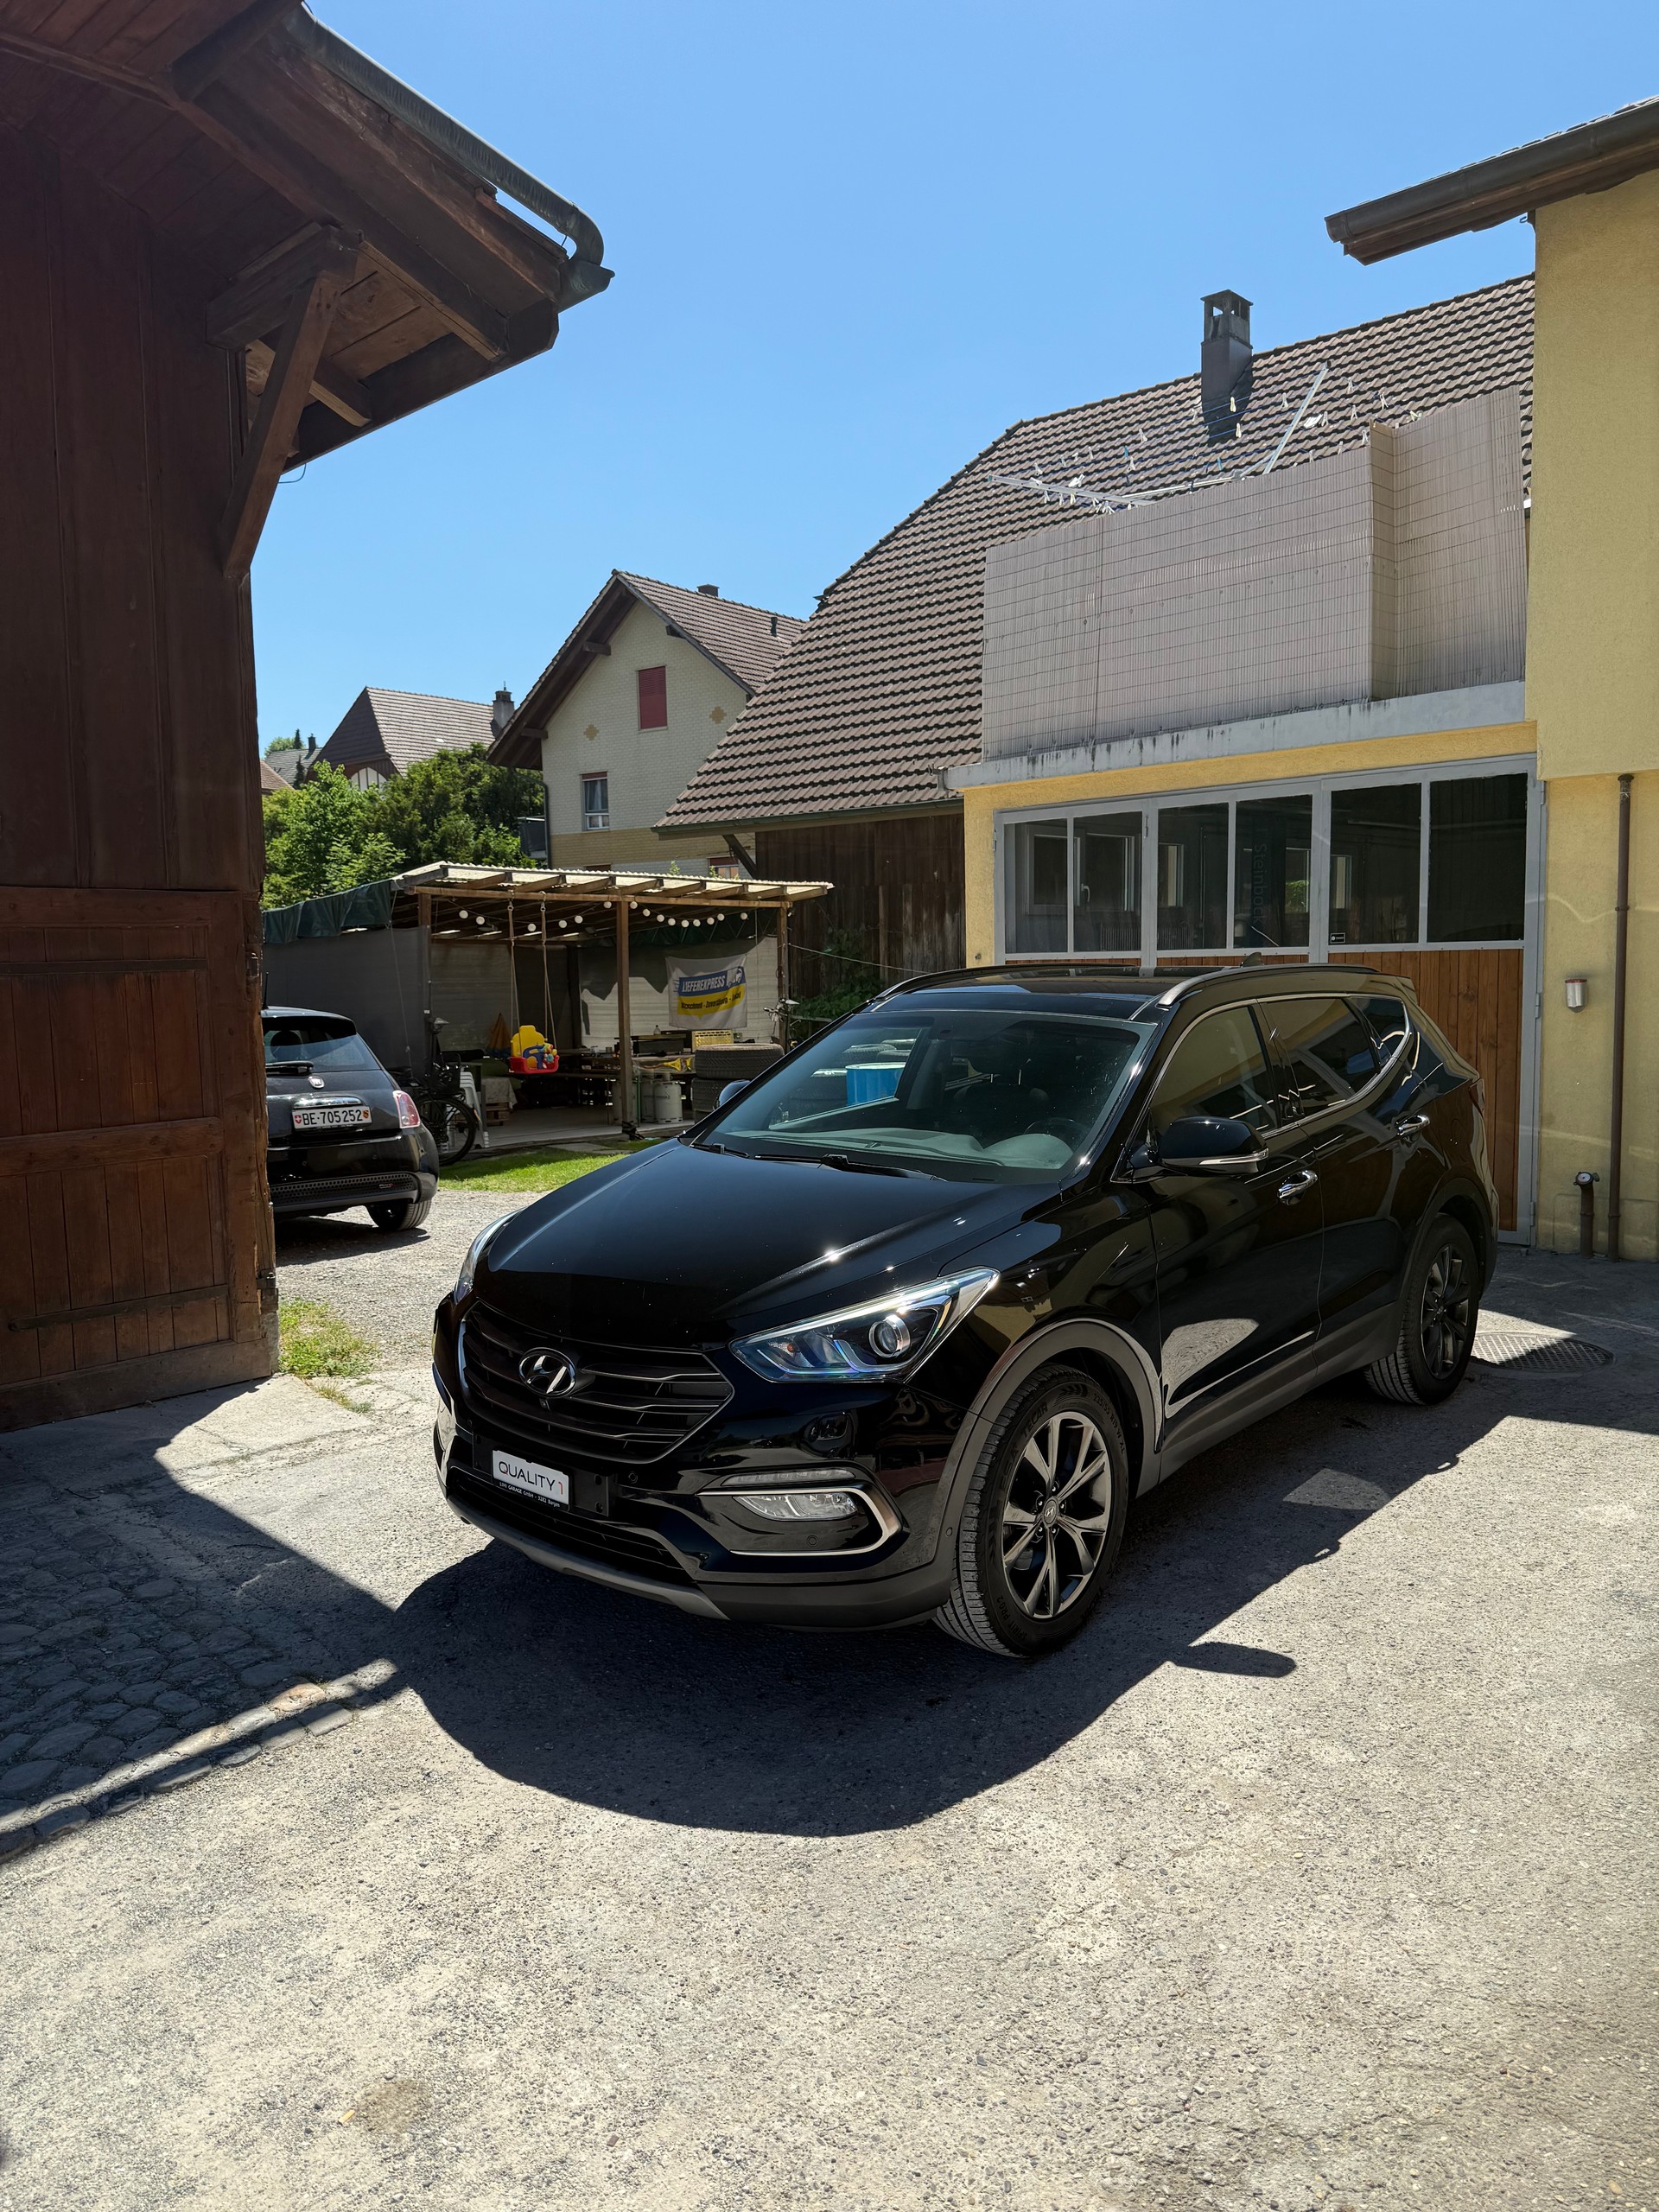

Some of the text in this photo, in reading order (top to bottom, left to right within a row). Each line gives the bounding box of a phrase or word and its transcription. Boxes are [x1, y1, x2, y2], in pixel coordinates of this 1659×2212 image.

[1253, 843, 1268, 924] Steinbock
[682, 976, 726, 992] LIEFEREXPRESS
[499, 1461, 556, 1491] QUALITY
[508, 1485, 523, 1494] GARAGE
[999, 1602, 1011, 1620] PRO
[1008, 1621, 1028, 1641] SPIRIT
